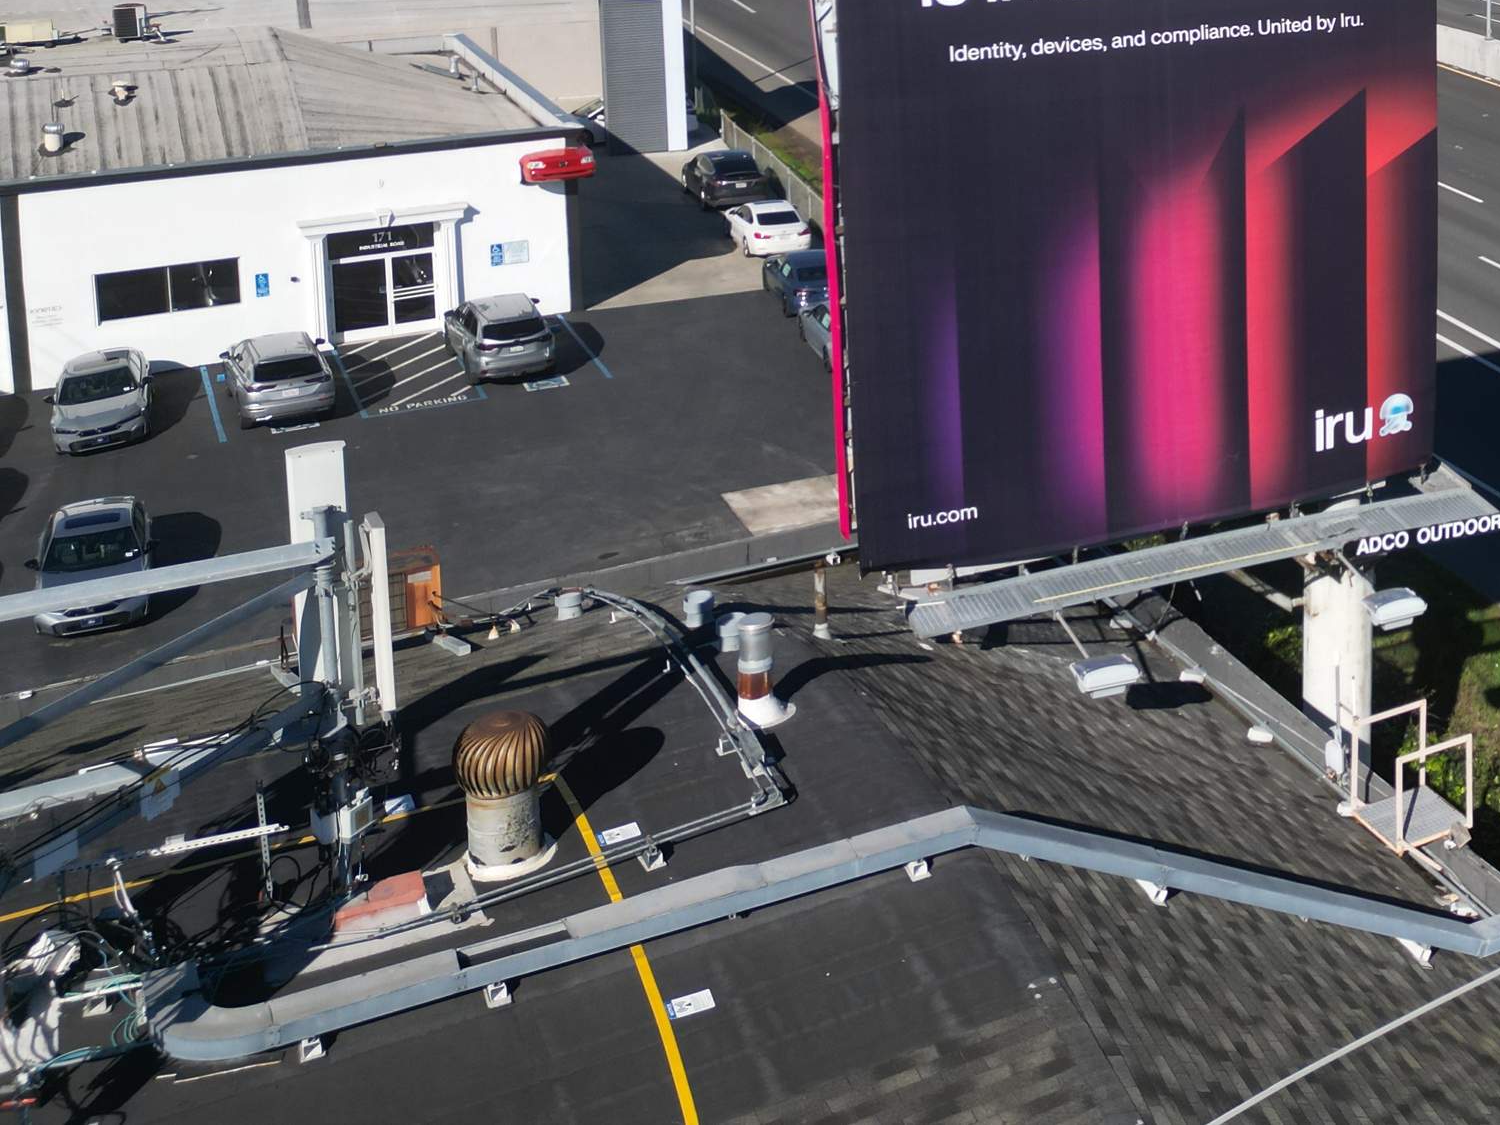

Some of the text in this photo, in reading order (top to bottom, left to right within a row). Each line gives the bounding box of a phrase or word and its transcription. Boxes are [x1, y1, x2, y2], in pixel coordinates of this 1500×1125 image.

[948, 12, 1364, 63] Identity, devices, and compliance. United by Iru.
[373, 231, 391, 242] 171
[378, 395, 468, 414] NO PARKING
[1315, 407, 1373, 452] iru
[907, 506, 978, 529] iru.com
[1356, 531, 1409, 556] ADCO
